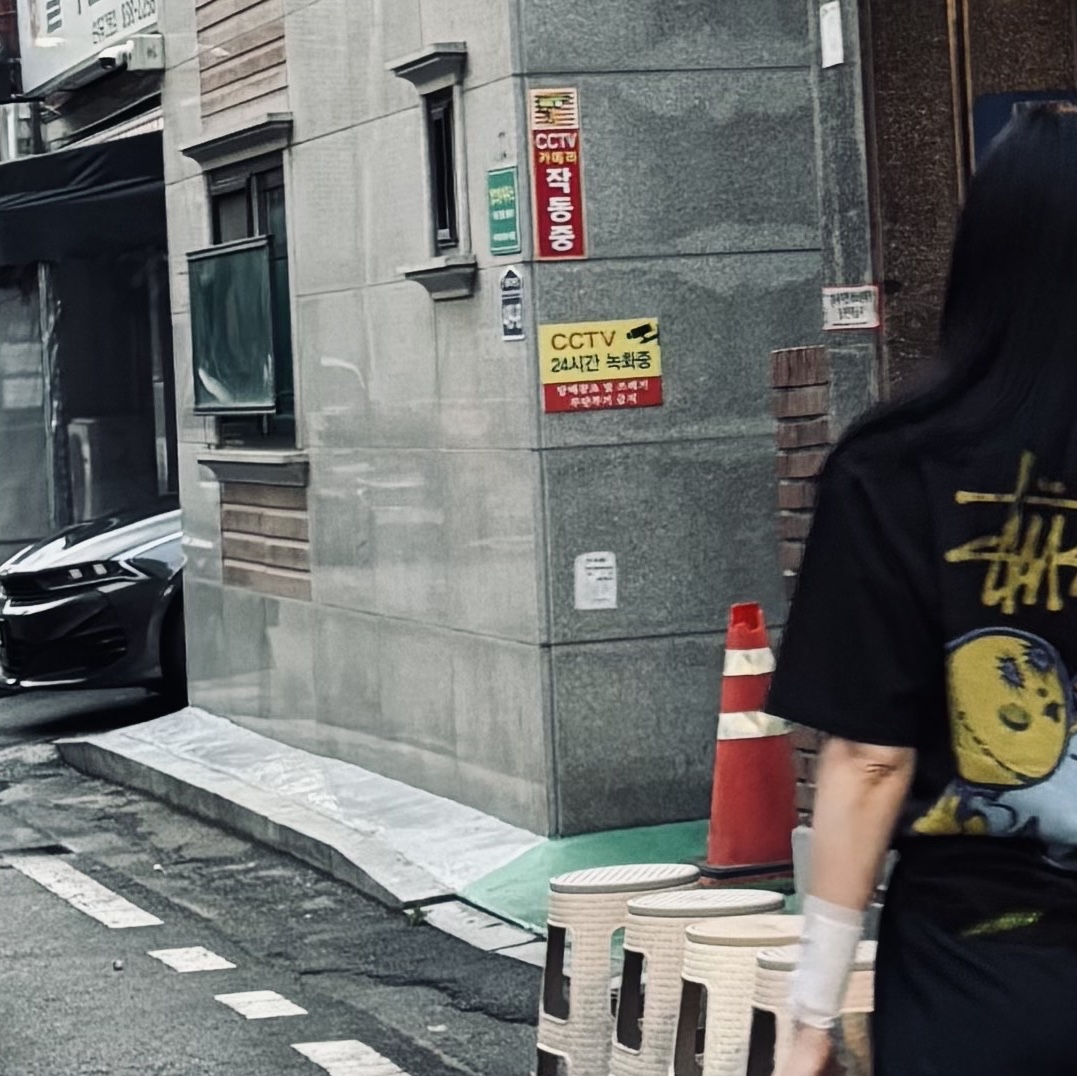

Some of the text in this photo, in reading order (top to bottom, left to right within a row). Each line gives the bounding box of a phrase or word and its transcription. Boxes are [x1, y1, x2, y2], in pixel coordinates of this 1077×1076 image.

[536, 133, 577, 149] CCTV
[546, 167, 576, 252] 작동중
[551, 330, 616, 350] CCTV
[551, 351, 652, 373] 24시간 녹화중
